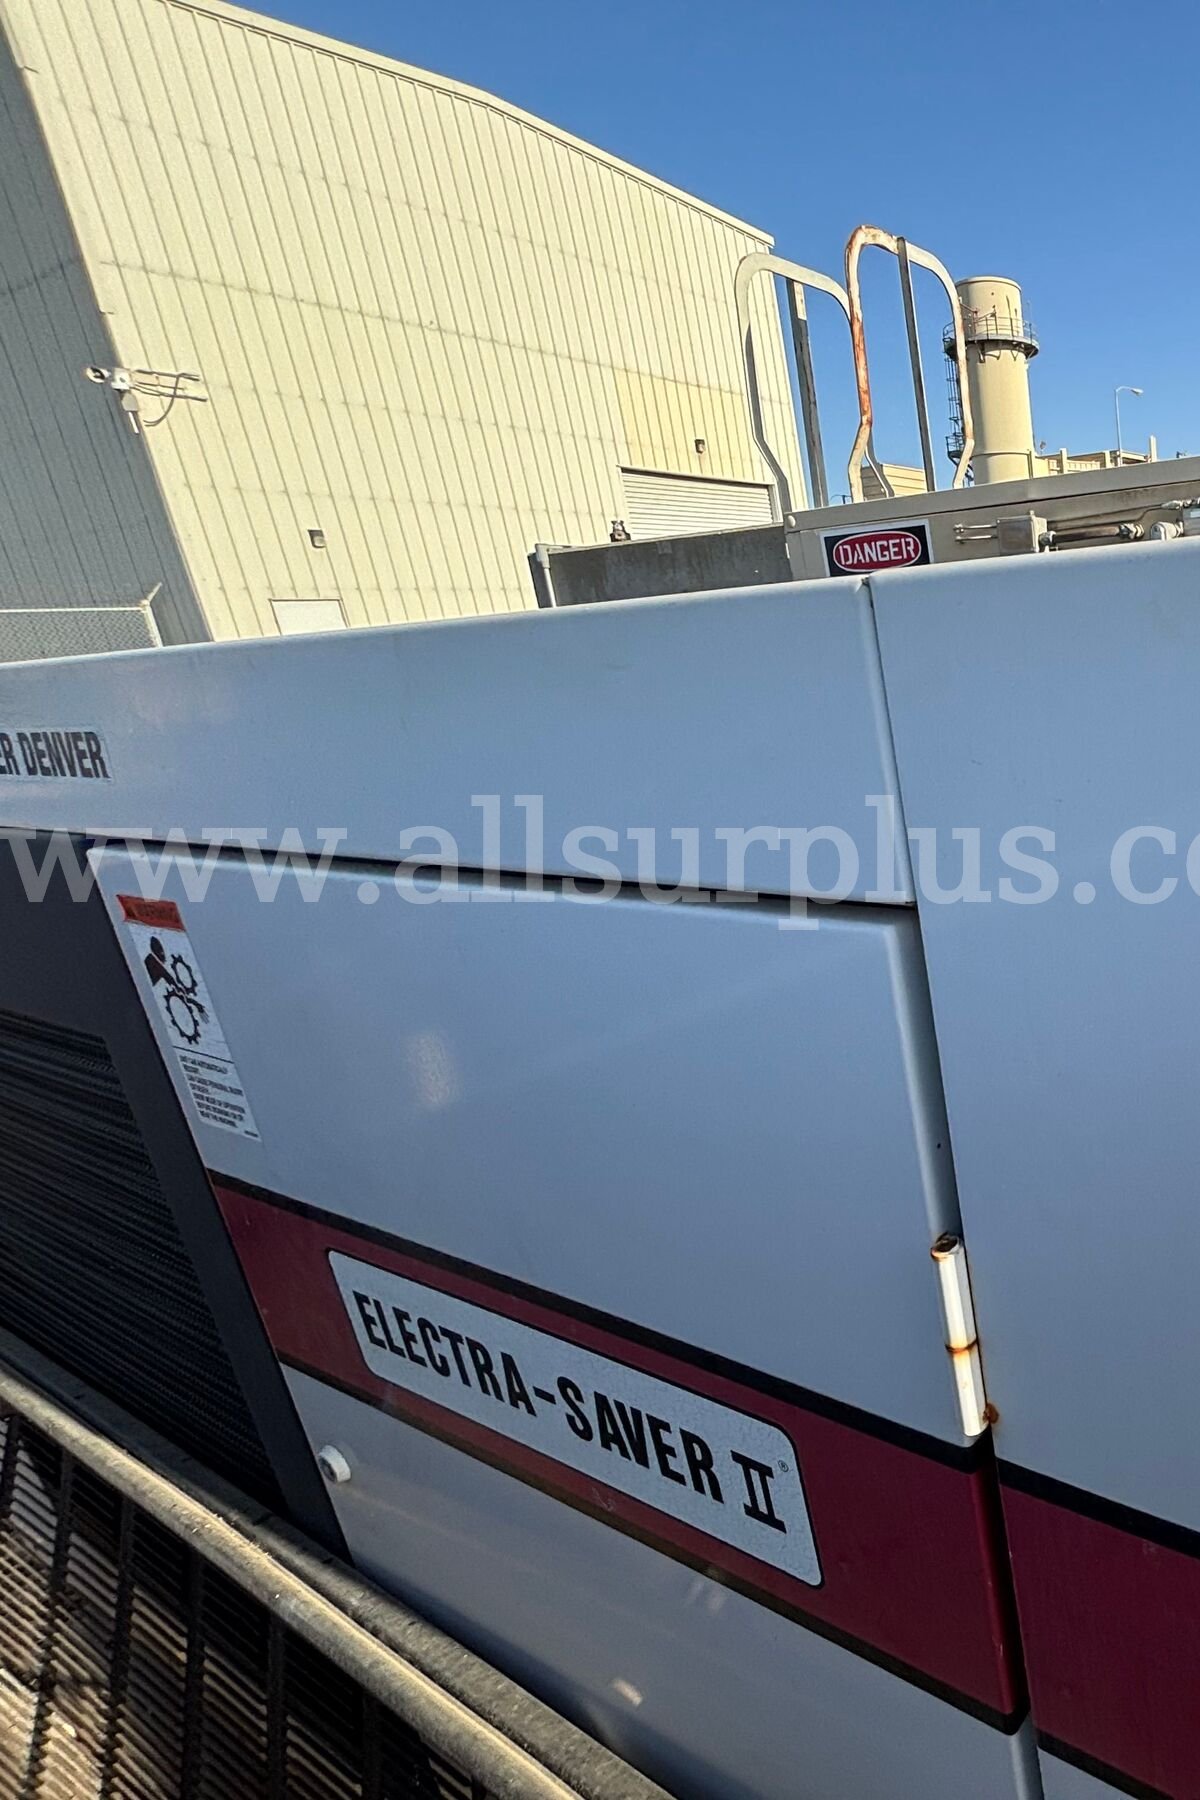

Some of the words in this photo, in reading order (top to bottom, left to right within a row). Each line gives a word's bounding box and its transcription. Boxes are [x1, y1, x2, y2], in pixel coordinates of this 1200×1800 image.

[838, 536, 915, 566] DANGER
[16, 731, 111, 778] DENVER
[352, 1290, 724, 1503] ELECTRA-SAVER
